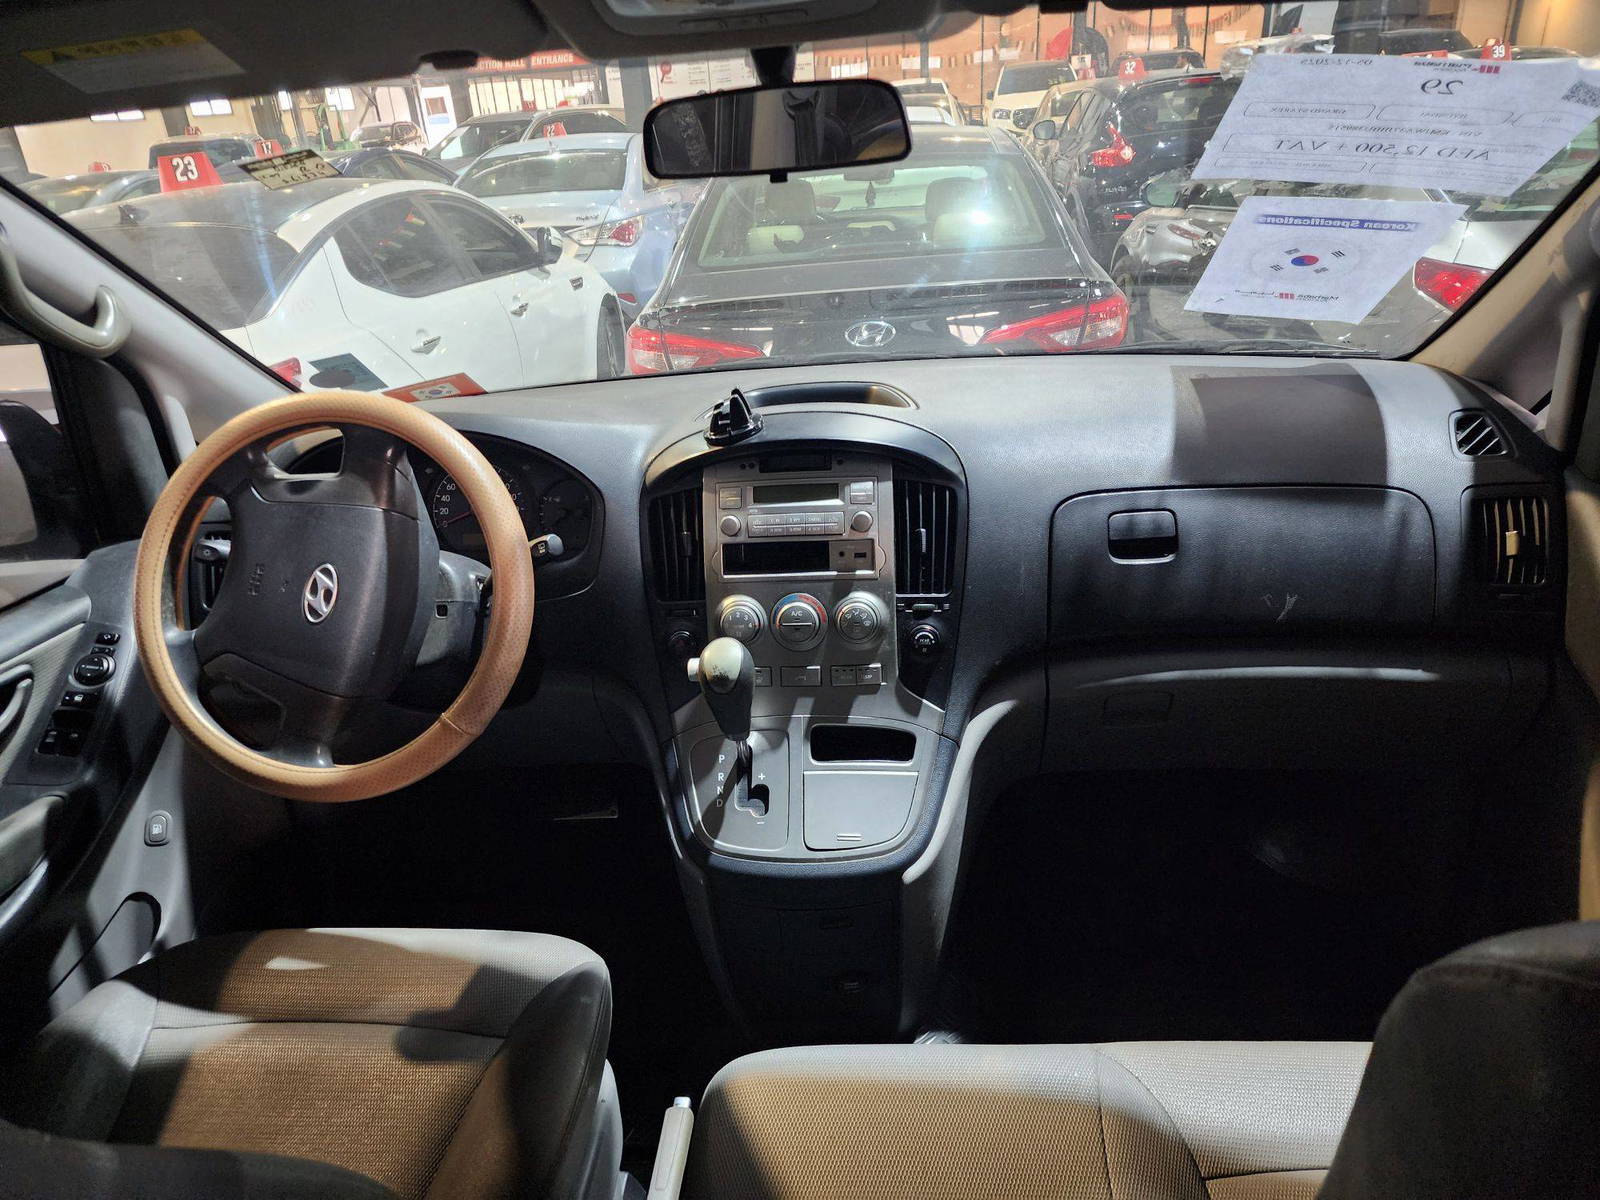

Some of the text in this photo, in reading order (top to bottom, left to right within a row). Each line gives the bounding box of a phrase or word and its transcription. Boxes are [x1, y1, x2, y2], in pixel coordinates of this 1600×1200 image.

[1491, 45, 1506, 58] 39
[531, 54, 574, 66] ENTRANCE
[1124, 61, 1137, 74] 32
[171, 155, 199, 183] 23
[446, 483, 456, 491] 60
[440, 494, 451, 502] 40
[439, 507, 449, 515] 20
[718, 754, 726, 764] P
[717, 772, 725, 781] R
[716, 786, 724, 795] N
[716, 799, 724, 808] D
